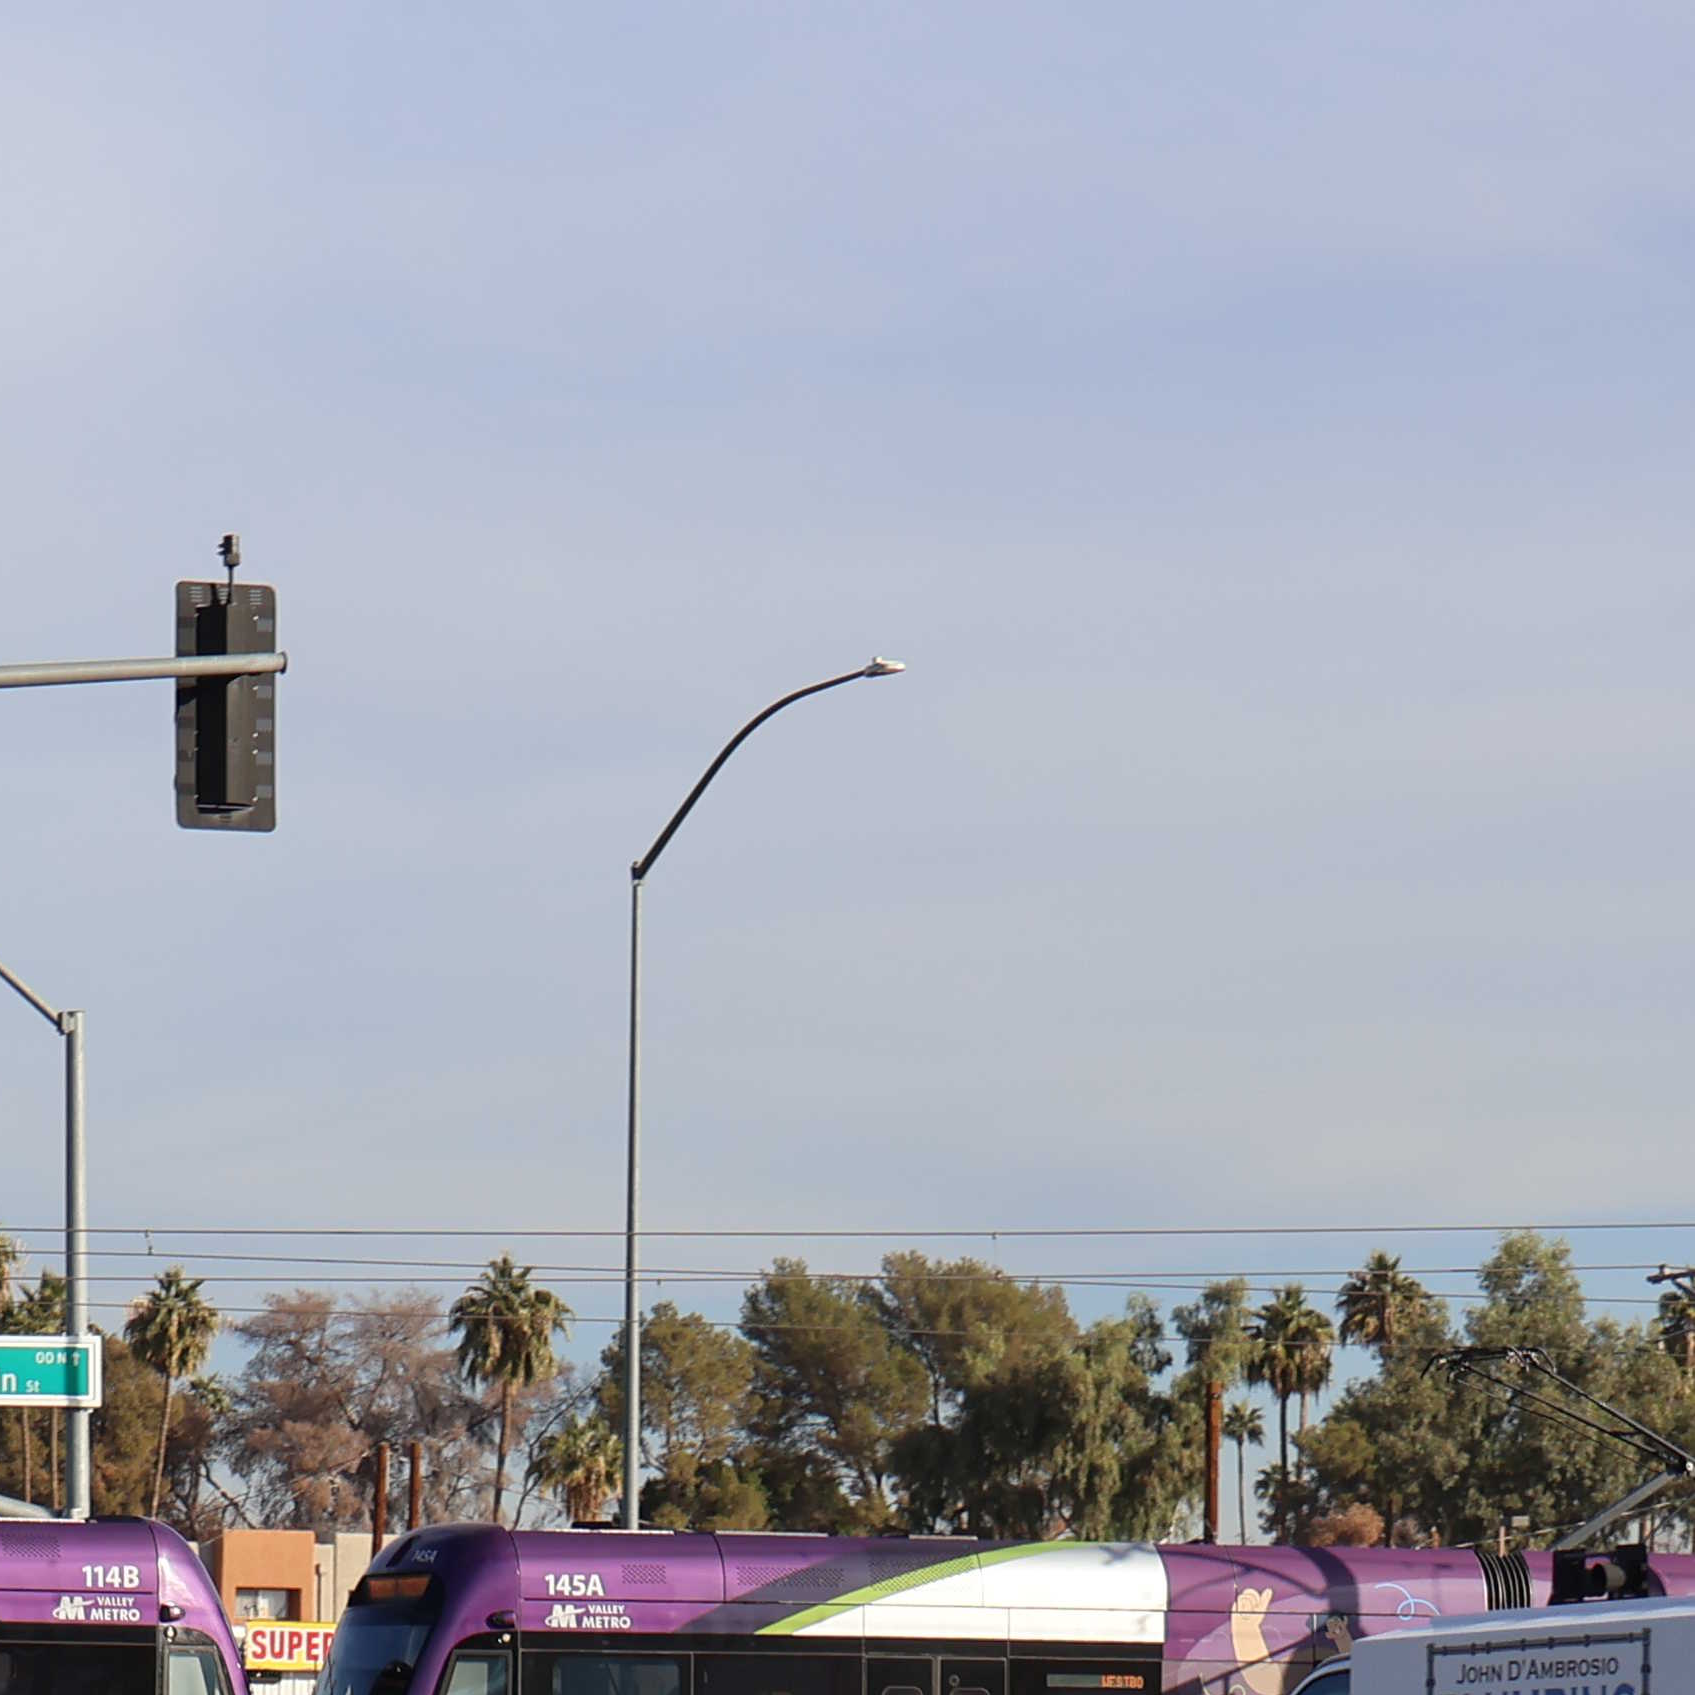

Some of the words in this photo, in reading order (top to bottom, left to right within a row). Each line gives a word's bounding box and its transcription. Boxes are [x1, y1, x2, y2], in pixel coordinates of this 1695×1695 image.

[57, 1351, 68, 1364] N
[25, 1379, 41, 1393] St
[81, 1565, 140, 1588] 114B
[544, 1573, 605, 1596] 145A
[96, 1595, 135, 1606] VALLEY
[89, 1608, 141, 1622] METRO
[587, 1604, 626, 1615] VALLEY
[581, 1615, 632, 1629] METRO
